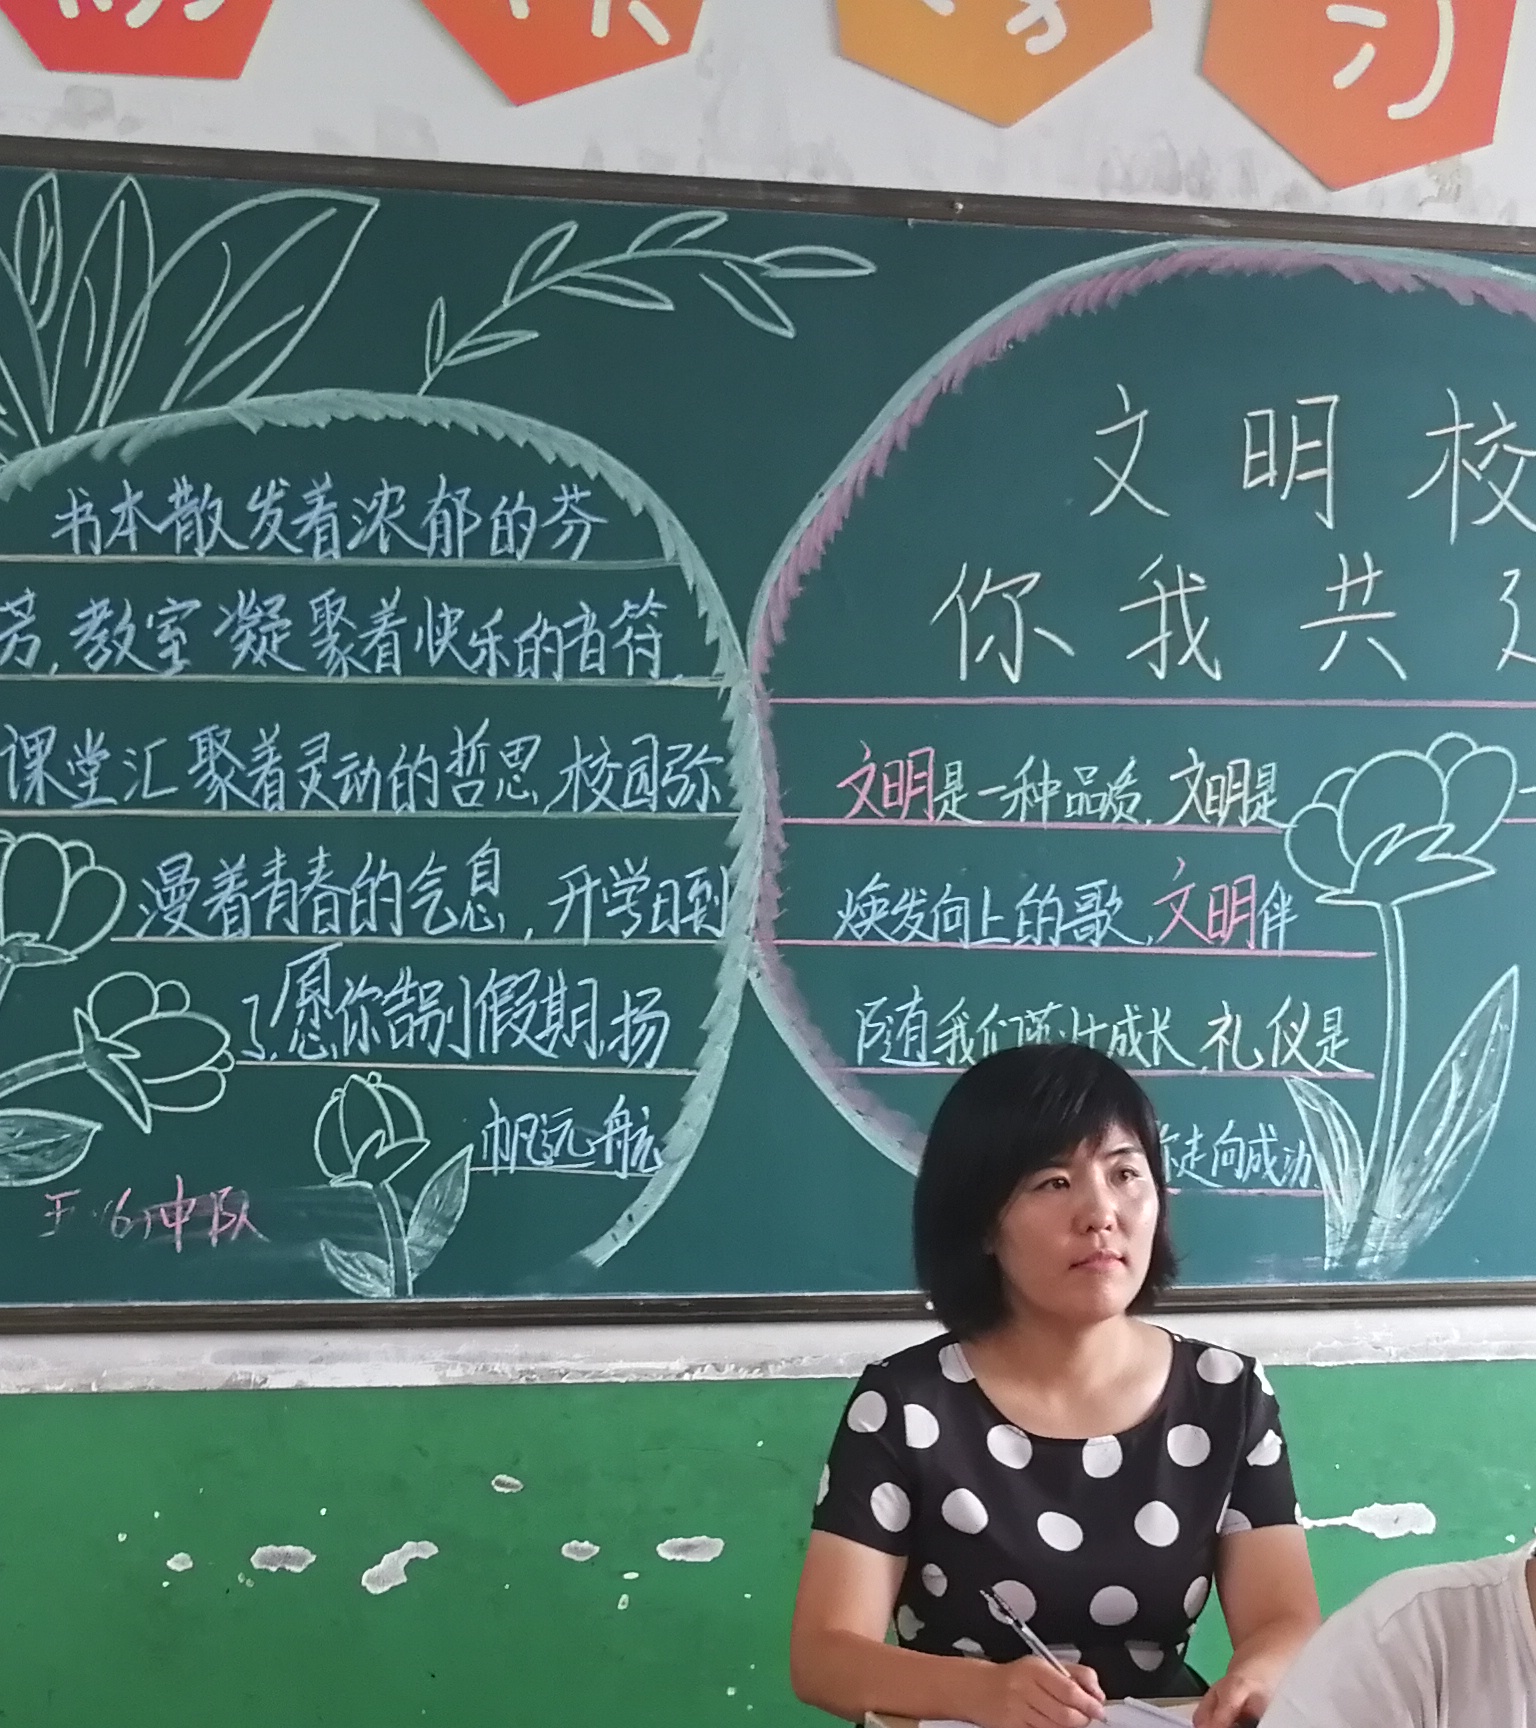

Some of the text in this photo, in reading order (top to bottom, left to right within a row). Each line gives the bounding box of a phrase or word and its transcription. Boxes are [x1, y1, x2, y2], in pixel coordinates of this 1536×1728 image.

[51, 470, 610, 559] 书本散发着浓郁的芬
[482, 1093, 664, 1179] 帆远航
